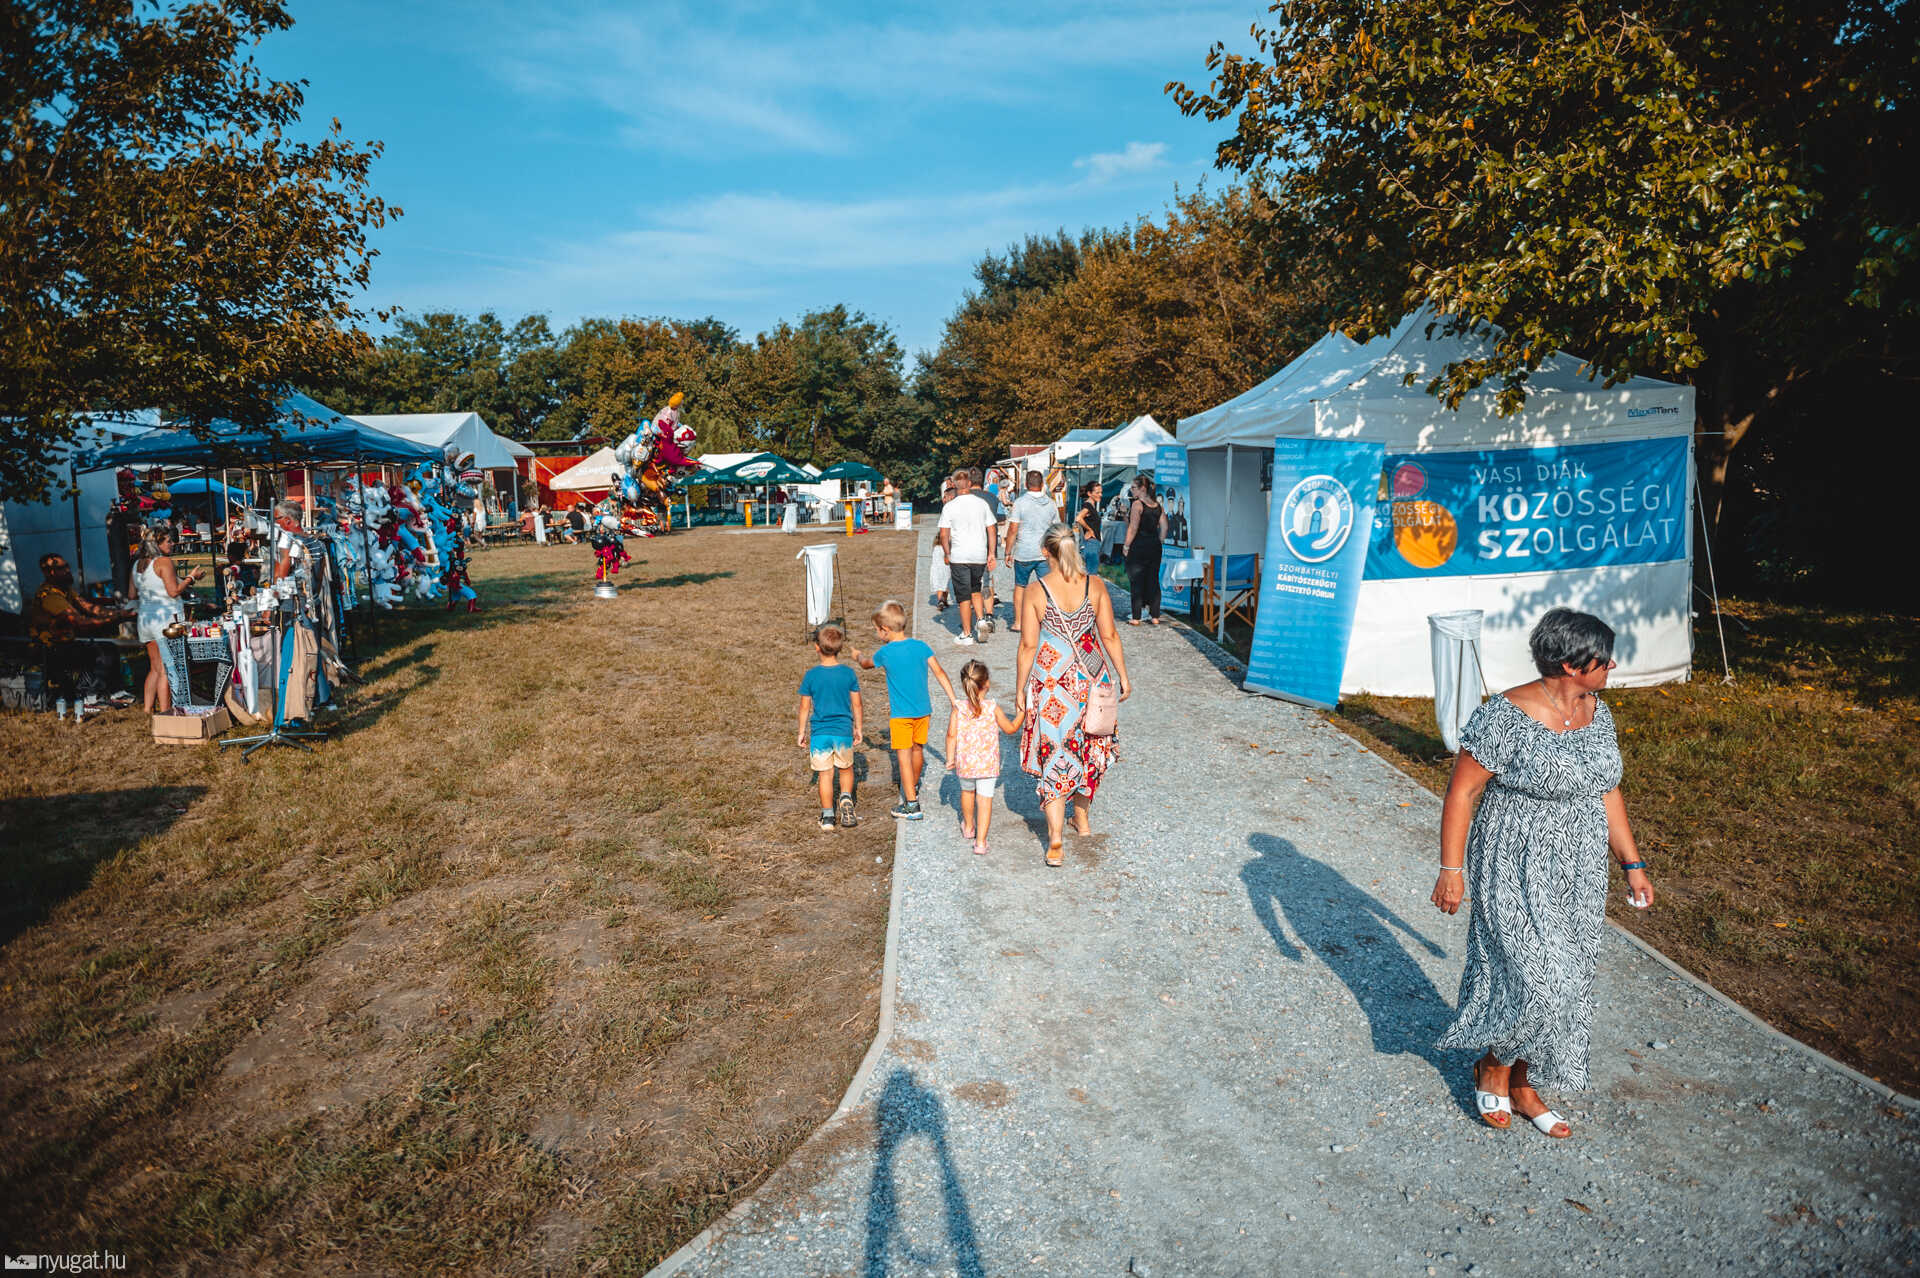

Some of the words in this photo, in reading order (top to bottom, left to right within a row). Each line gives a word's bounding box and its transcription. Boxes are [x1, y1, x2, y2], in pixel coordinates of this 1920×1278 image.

[1475, 466, 1522, 485] VASI
[1537, 459, 1587, 482] DIÁK
[1478, 480, 1671, 523] KÖZÖSSÉGI
[1478, 516, 1675, 560] SZOLGÁLAT
[1279, 564, 1339, 579] SZOMBATHELYI
